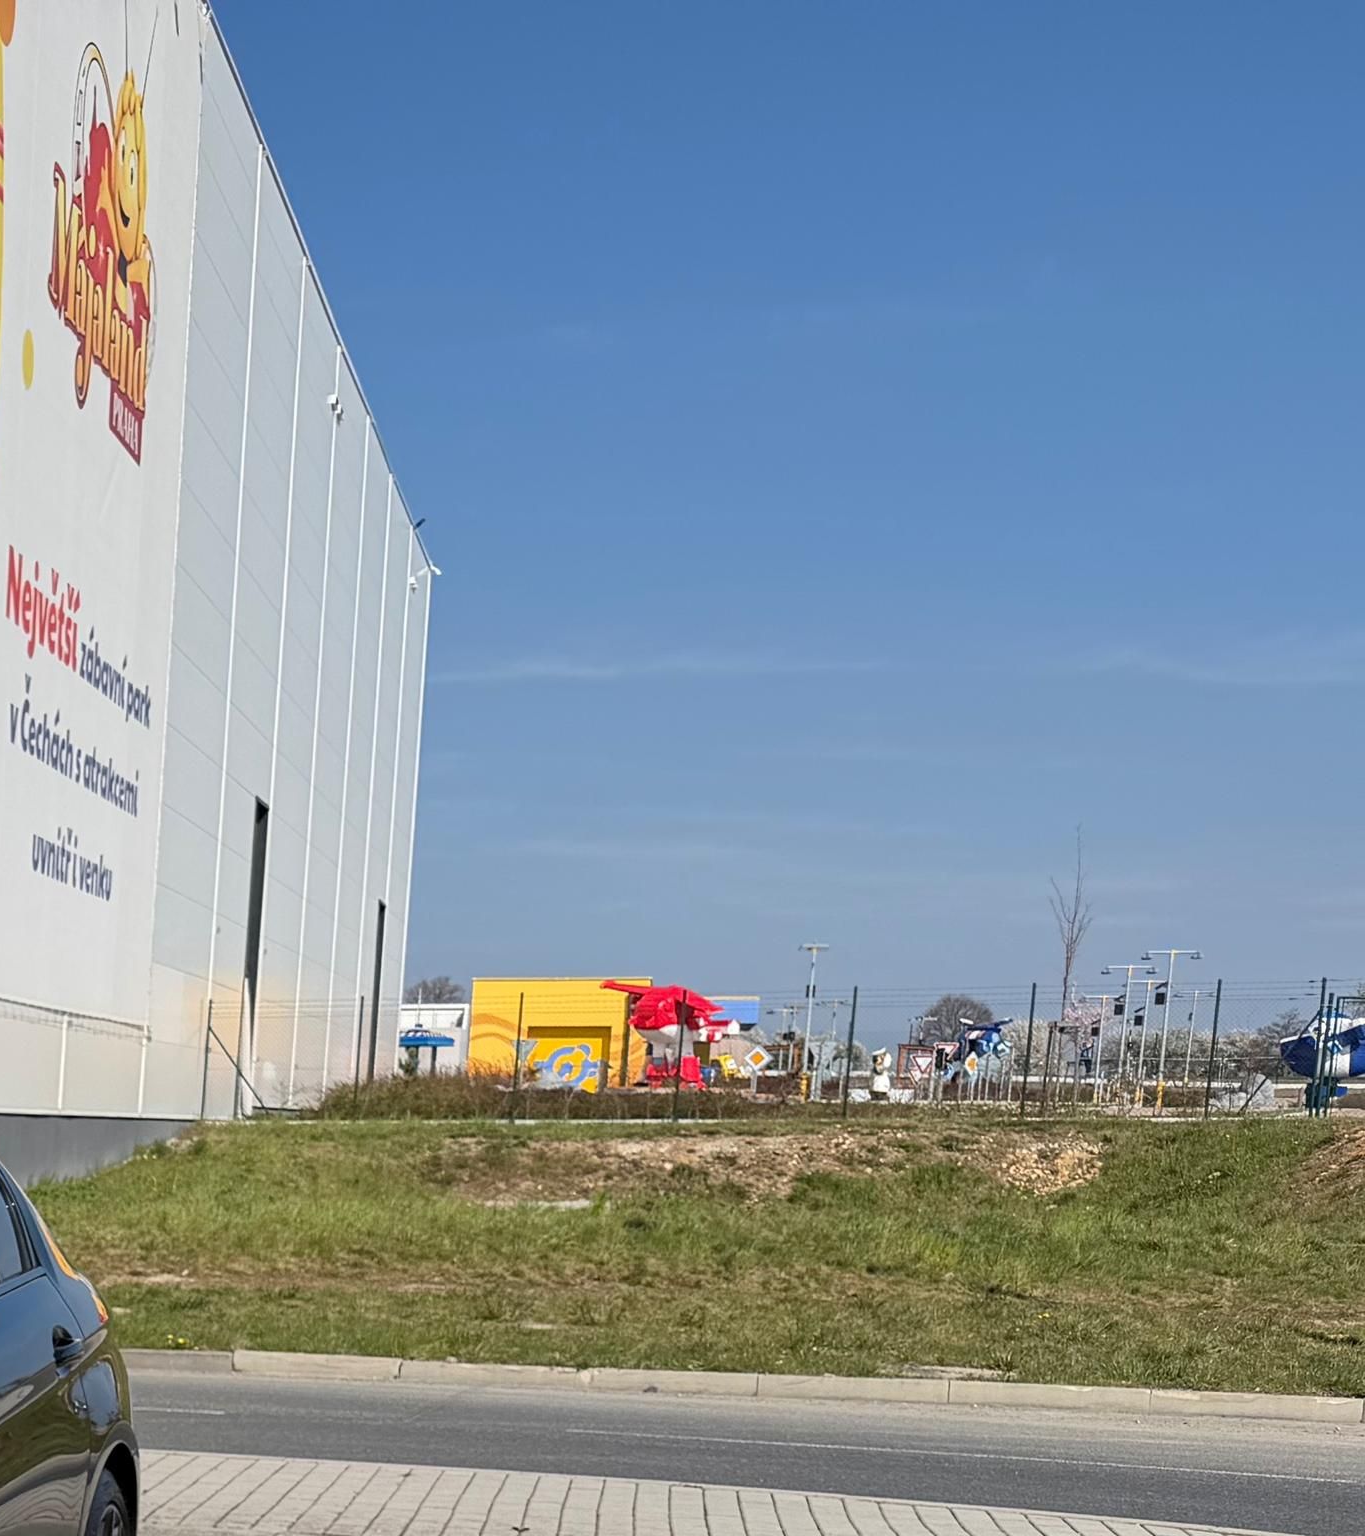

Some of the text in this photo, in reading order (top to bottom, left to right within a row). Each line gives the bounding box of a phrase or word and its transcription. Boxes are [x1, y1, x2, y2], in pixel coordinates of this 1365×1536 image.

[48, 165, 149, 411] Majaland
[112, 392, 139, 456] PRAHA
[5, 544, 151, 729] Největší zábavní park
[9, 672, 139, 818] v Čechách s atrakcemi
[31, 827, 113, 902] uvnitř i venku
